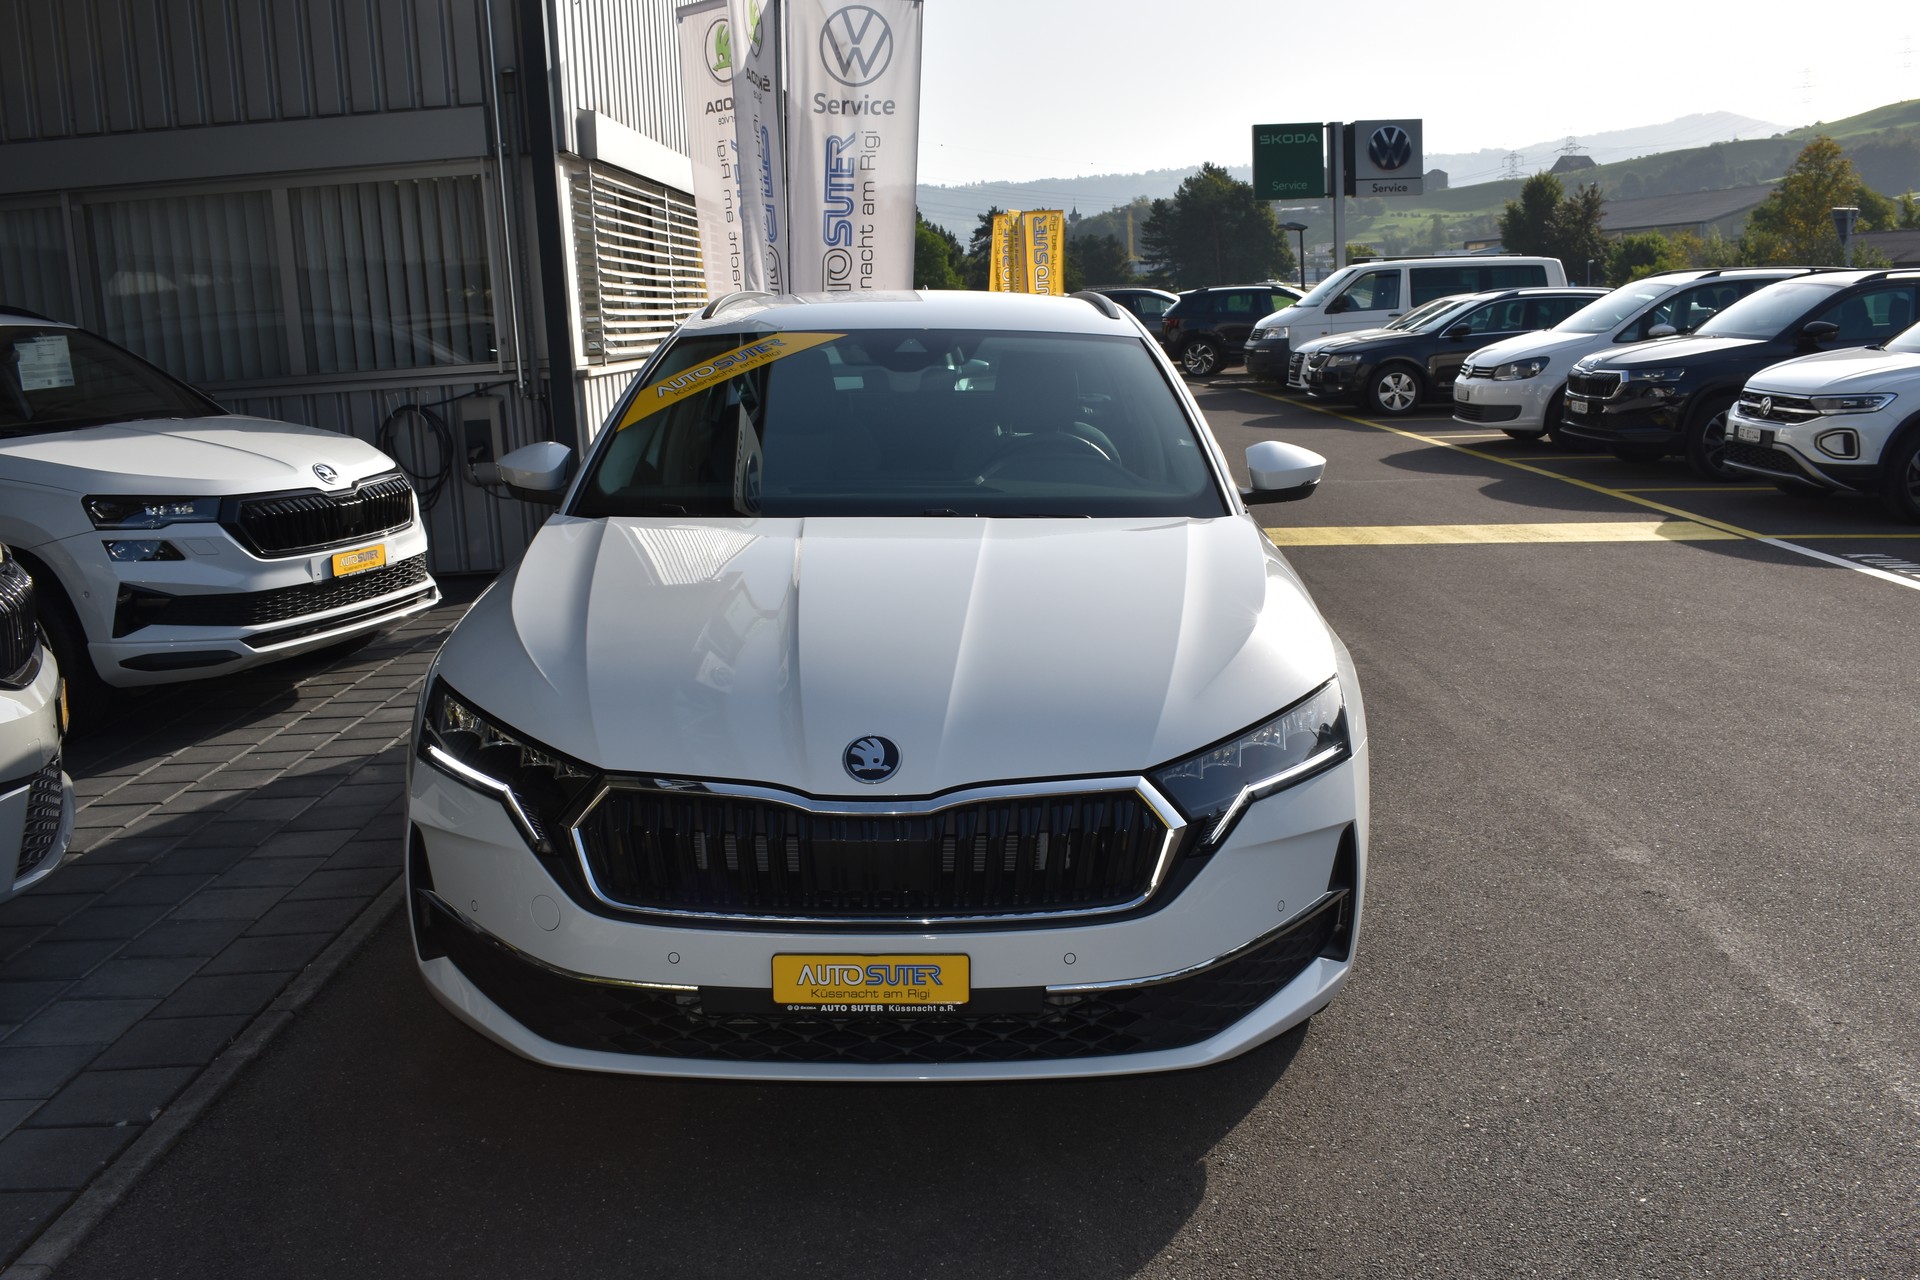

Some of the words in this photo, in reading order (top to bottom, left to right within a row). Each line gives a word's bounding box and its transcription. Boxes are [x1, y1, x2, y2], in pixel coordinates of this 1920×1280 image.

[813, 93, 896, 116] Service
[860, 130, 881, 171] Rigi
[1272, 181, 1308, 191] Service
[1372, 183, 1408, 193] Service
[862, 181, 876, 216] am
[857, 224, 874, 289] nacht
[1033, 215, 1050, 295] UTOSUTER
[810, 988, 879, 999] Küssnacht
[883, 989, 903, 999] am
[907, 988, 930, 1000] Rigi
[820, 1004, 848, 1012] AUTO
[850, 1004, 884, 1012] SUTER
[888, 1003, 937, 1012] Küssnacht
